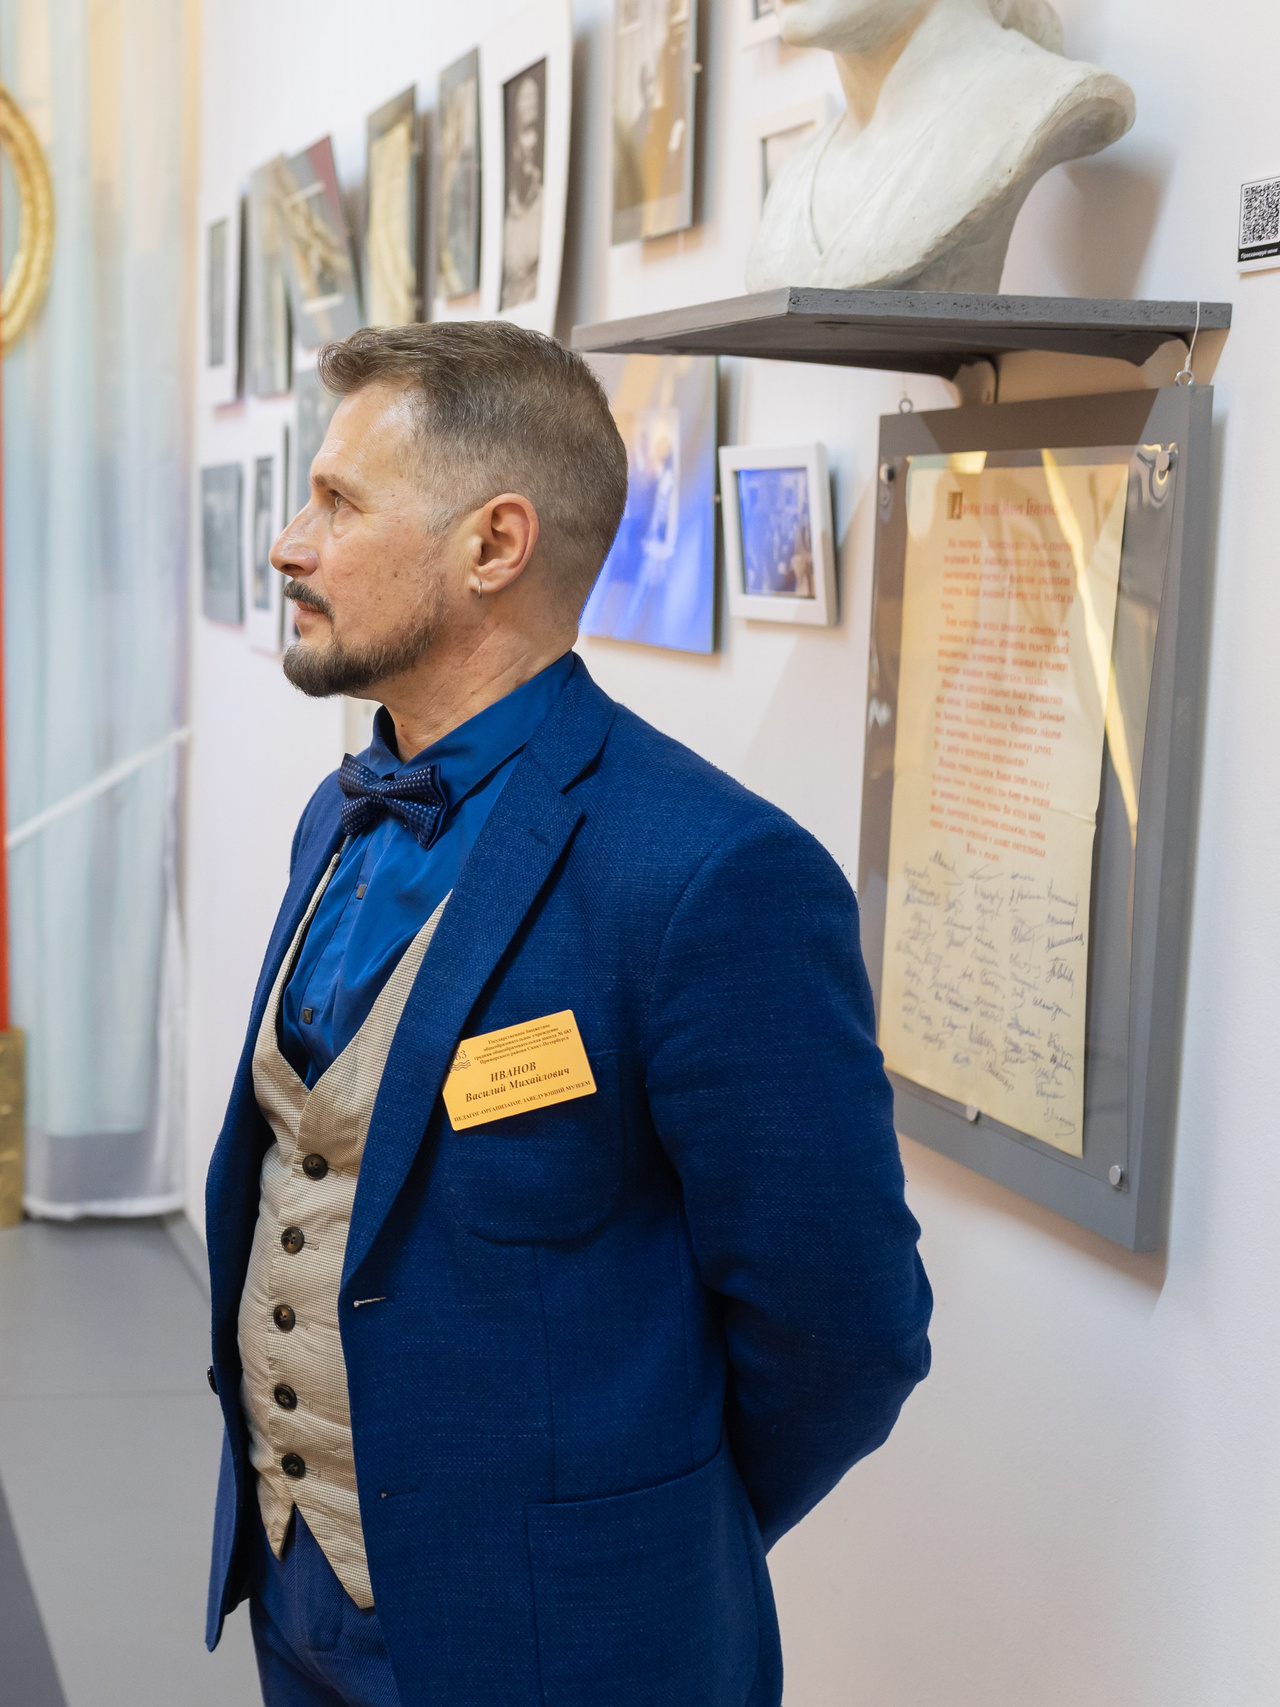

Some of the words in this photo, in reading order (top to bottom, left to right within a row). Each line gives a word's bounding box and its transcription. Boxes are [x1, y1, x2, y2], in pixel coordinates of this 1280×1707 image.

[491, 1062, 536, 1082] ИВАНОВ
[466, 1084, 506, 1102] Василий
[510, 1068, 569, 1089] Михайлович
[566, 1081, 591, 1090] МУЗЕЕМ
